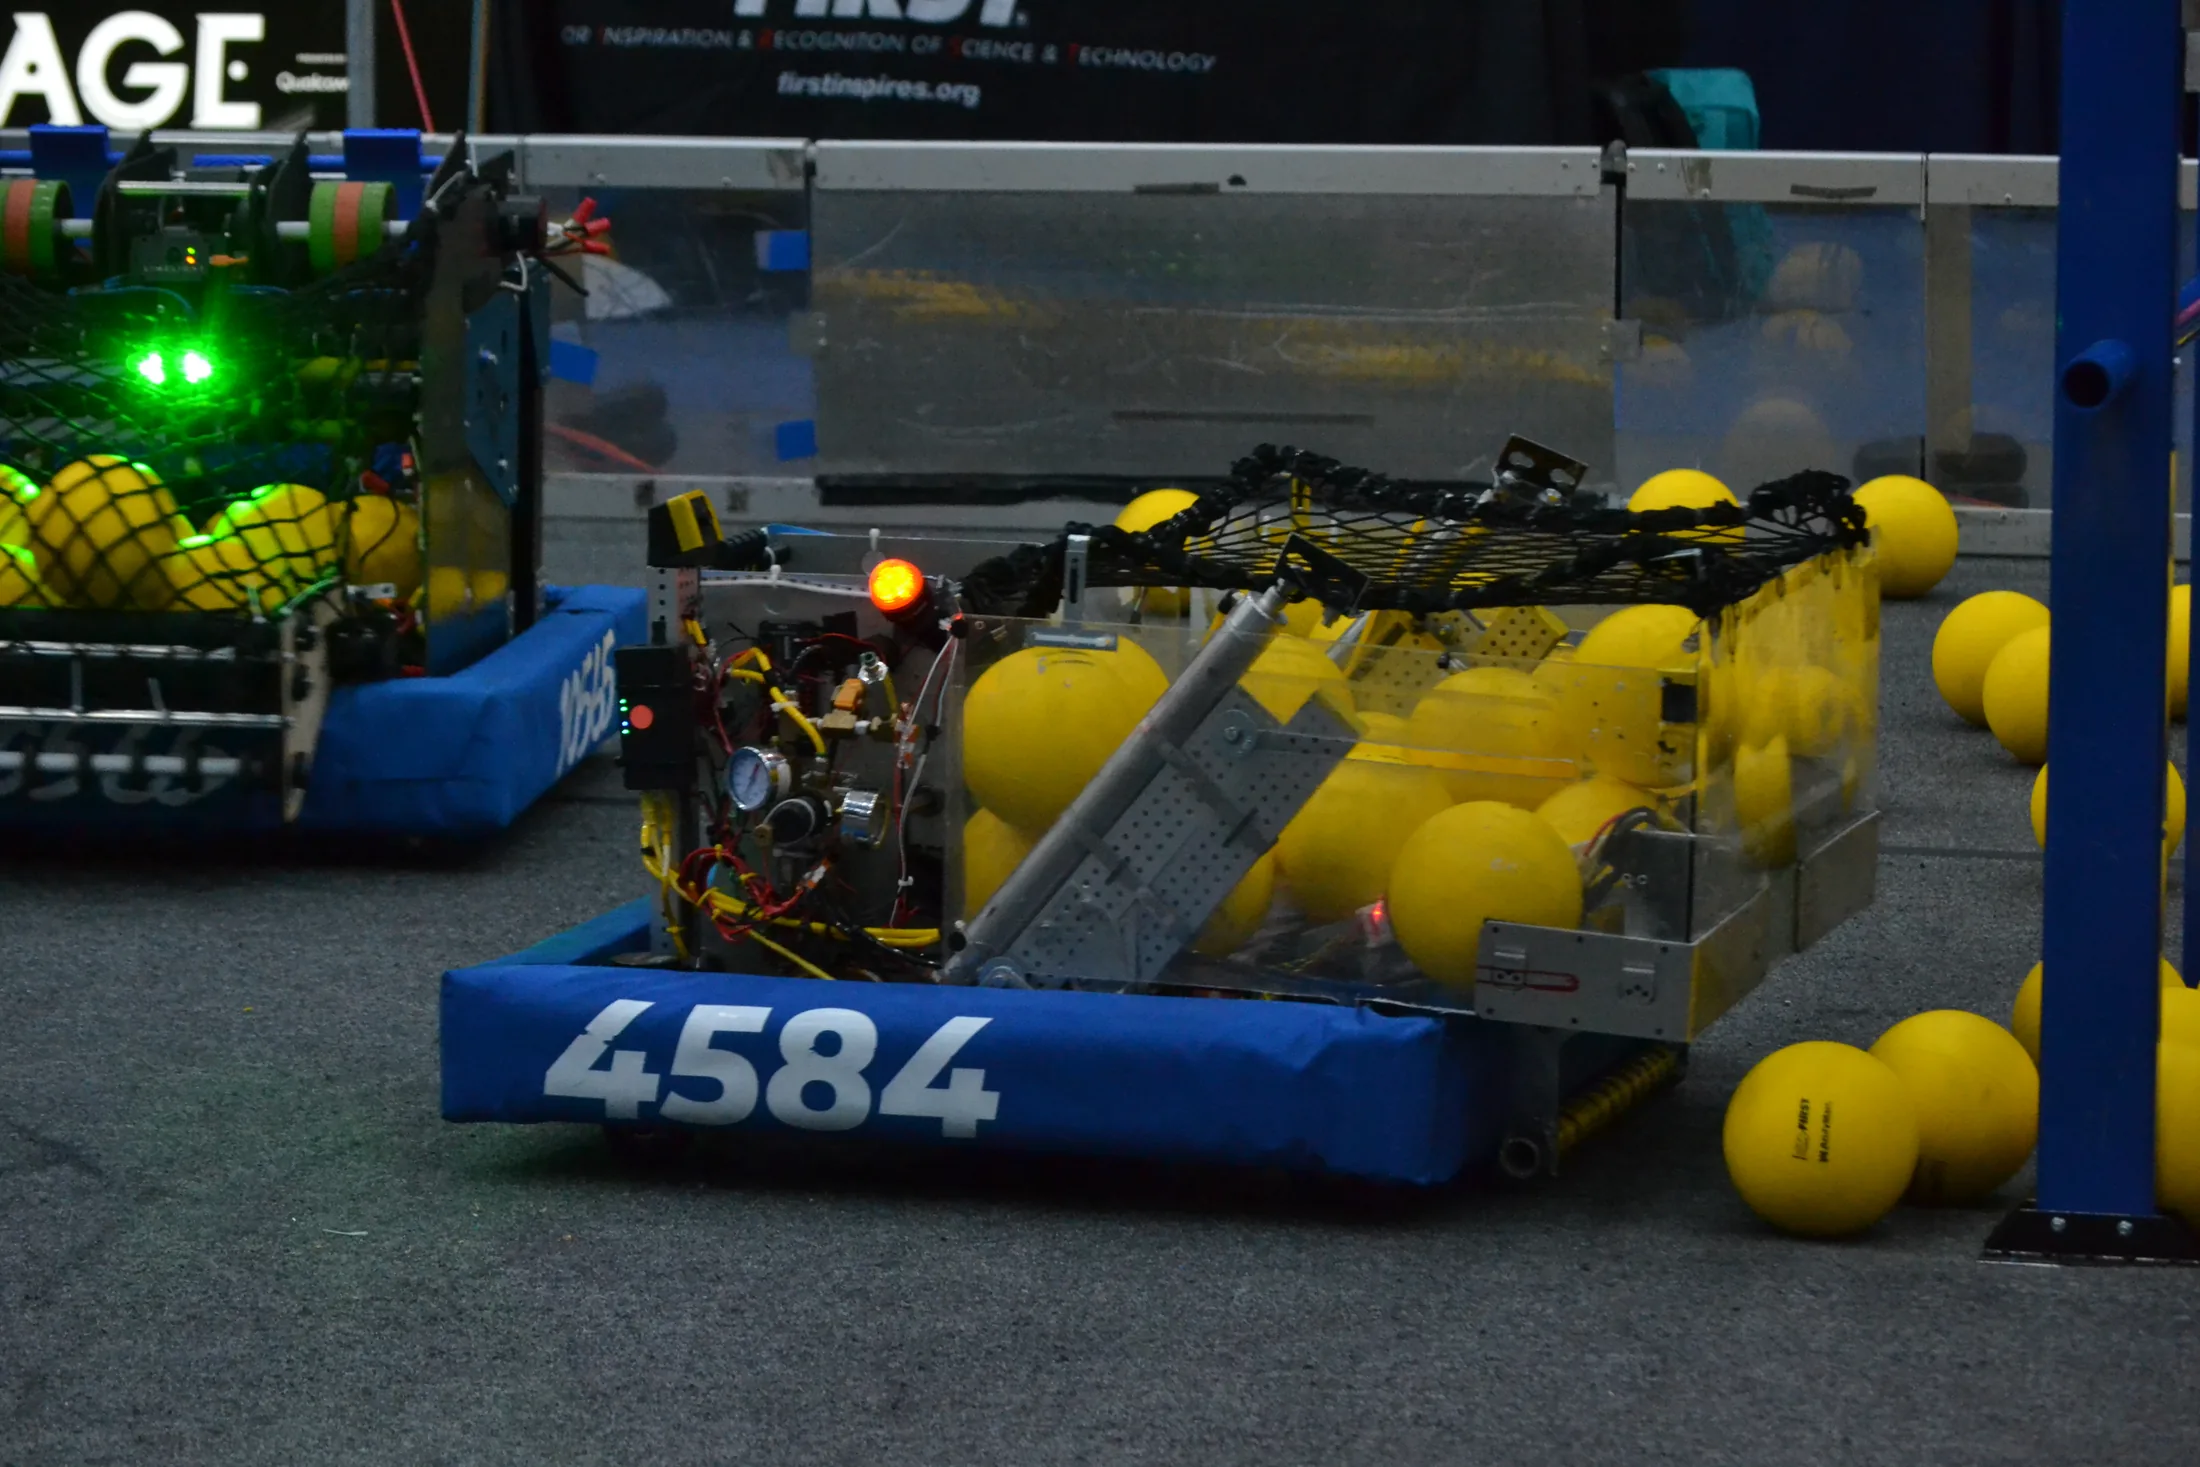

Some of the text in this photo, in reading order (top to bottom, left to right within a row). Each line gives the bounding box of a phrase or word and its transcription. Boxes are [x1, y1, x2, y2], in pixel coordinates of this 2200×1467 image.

[0, 10, 266, 129] AGE
[596, 24, 733, 50] INSPIRATION
[737, 28, 754, 48] &
[911, 33, 943, 55] OF
[948, 34, 1036, 64] SCIENCE
[1041, 42, 1059, 65] &
[1067, 42, 1218, 73] TECHNOLOGY
[777, 69, 982, 109] firstinspires.org
[543, 998, 1000, 1138] 4584
